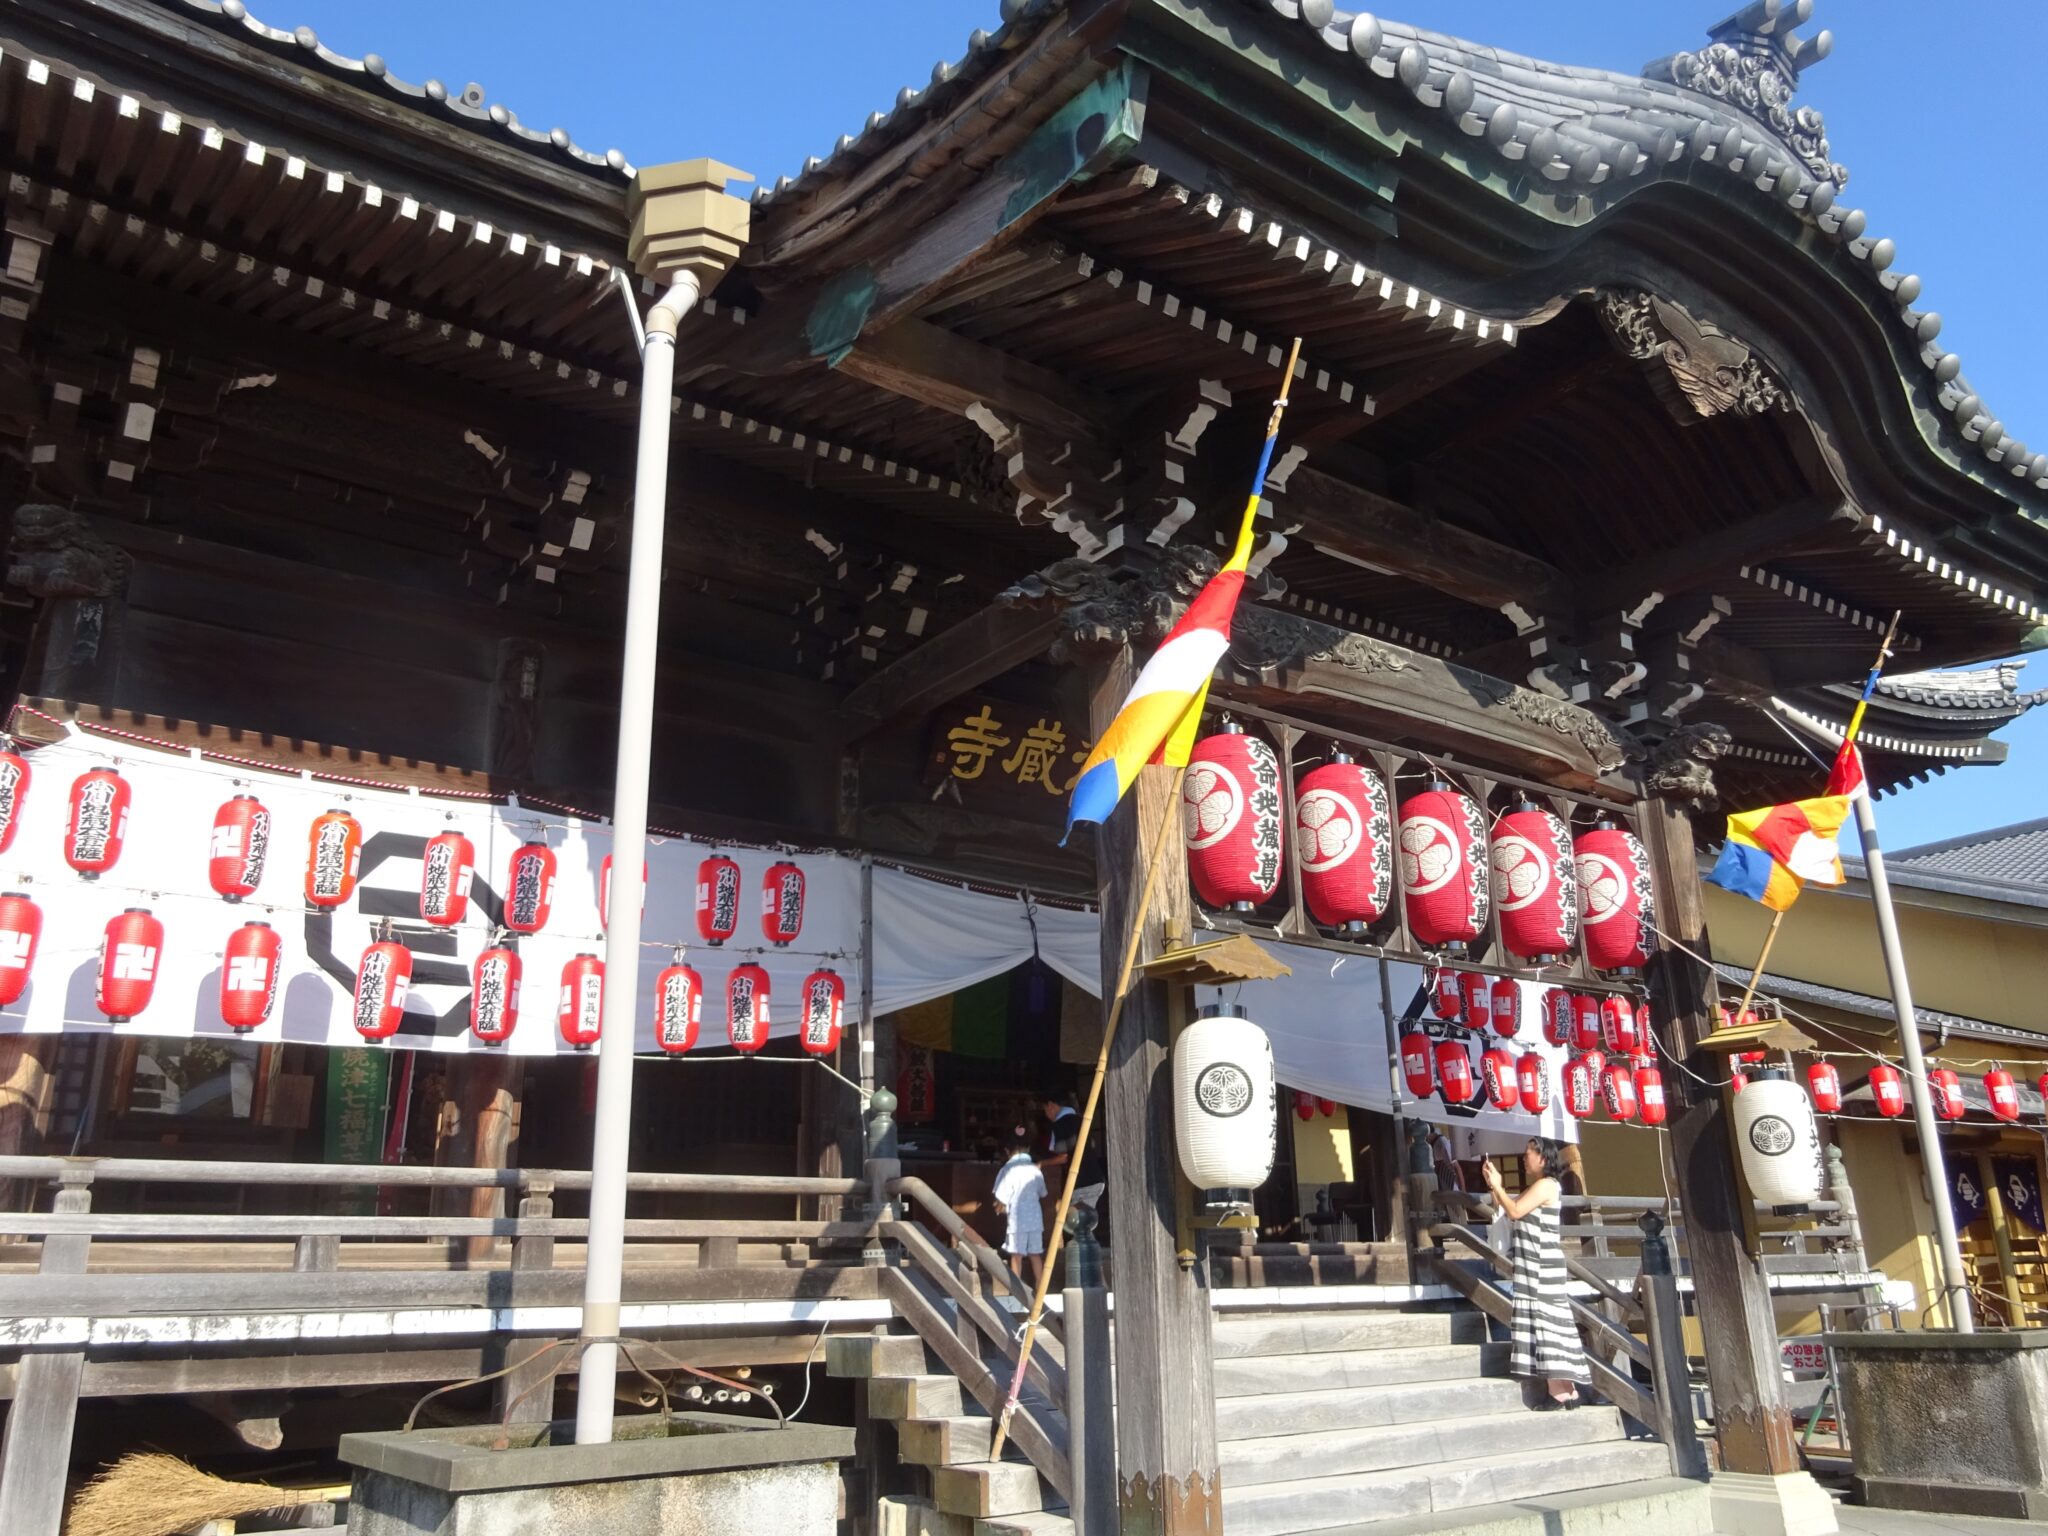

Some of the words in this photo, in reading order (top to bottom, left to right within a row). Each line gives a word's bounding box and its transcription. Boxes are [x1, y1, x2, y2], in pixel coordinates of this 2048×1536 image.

[1247, 736, 1281, 891] 延命地蔵尊
[1360, 767, 1391, 913] 延命地蔵尊
